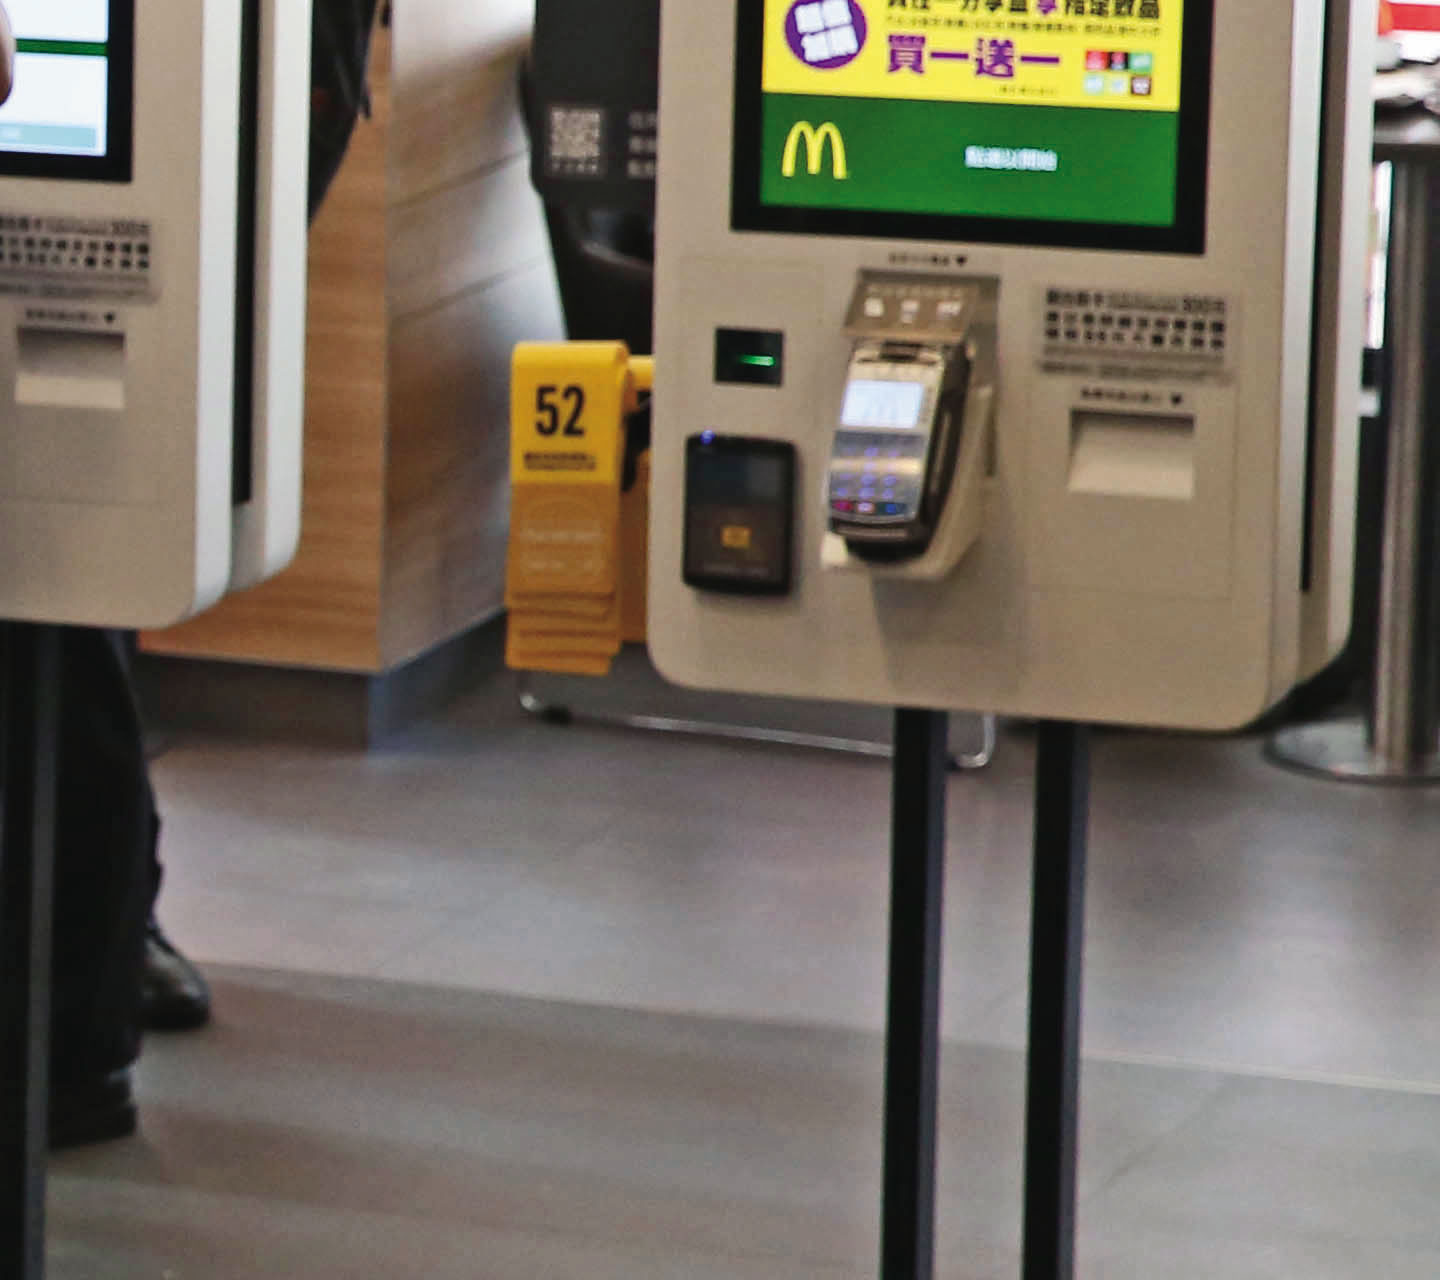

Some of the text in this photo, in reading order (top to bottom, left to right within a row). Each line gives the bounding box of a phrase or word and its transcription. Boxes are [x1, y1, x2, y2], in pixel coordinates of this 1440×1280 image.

[886, 34, 1060, 78] 買一送一
[536, 385, 585, 436] 52
